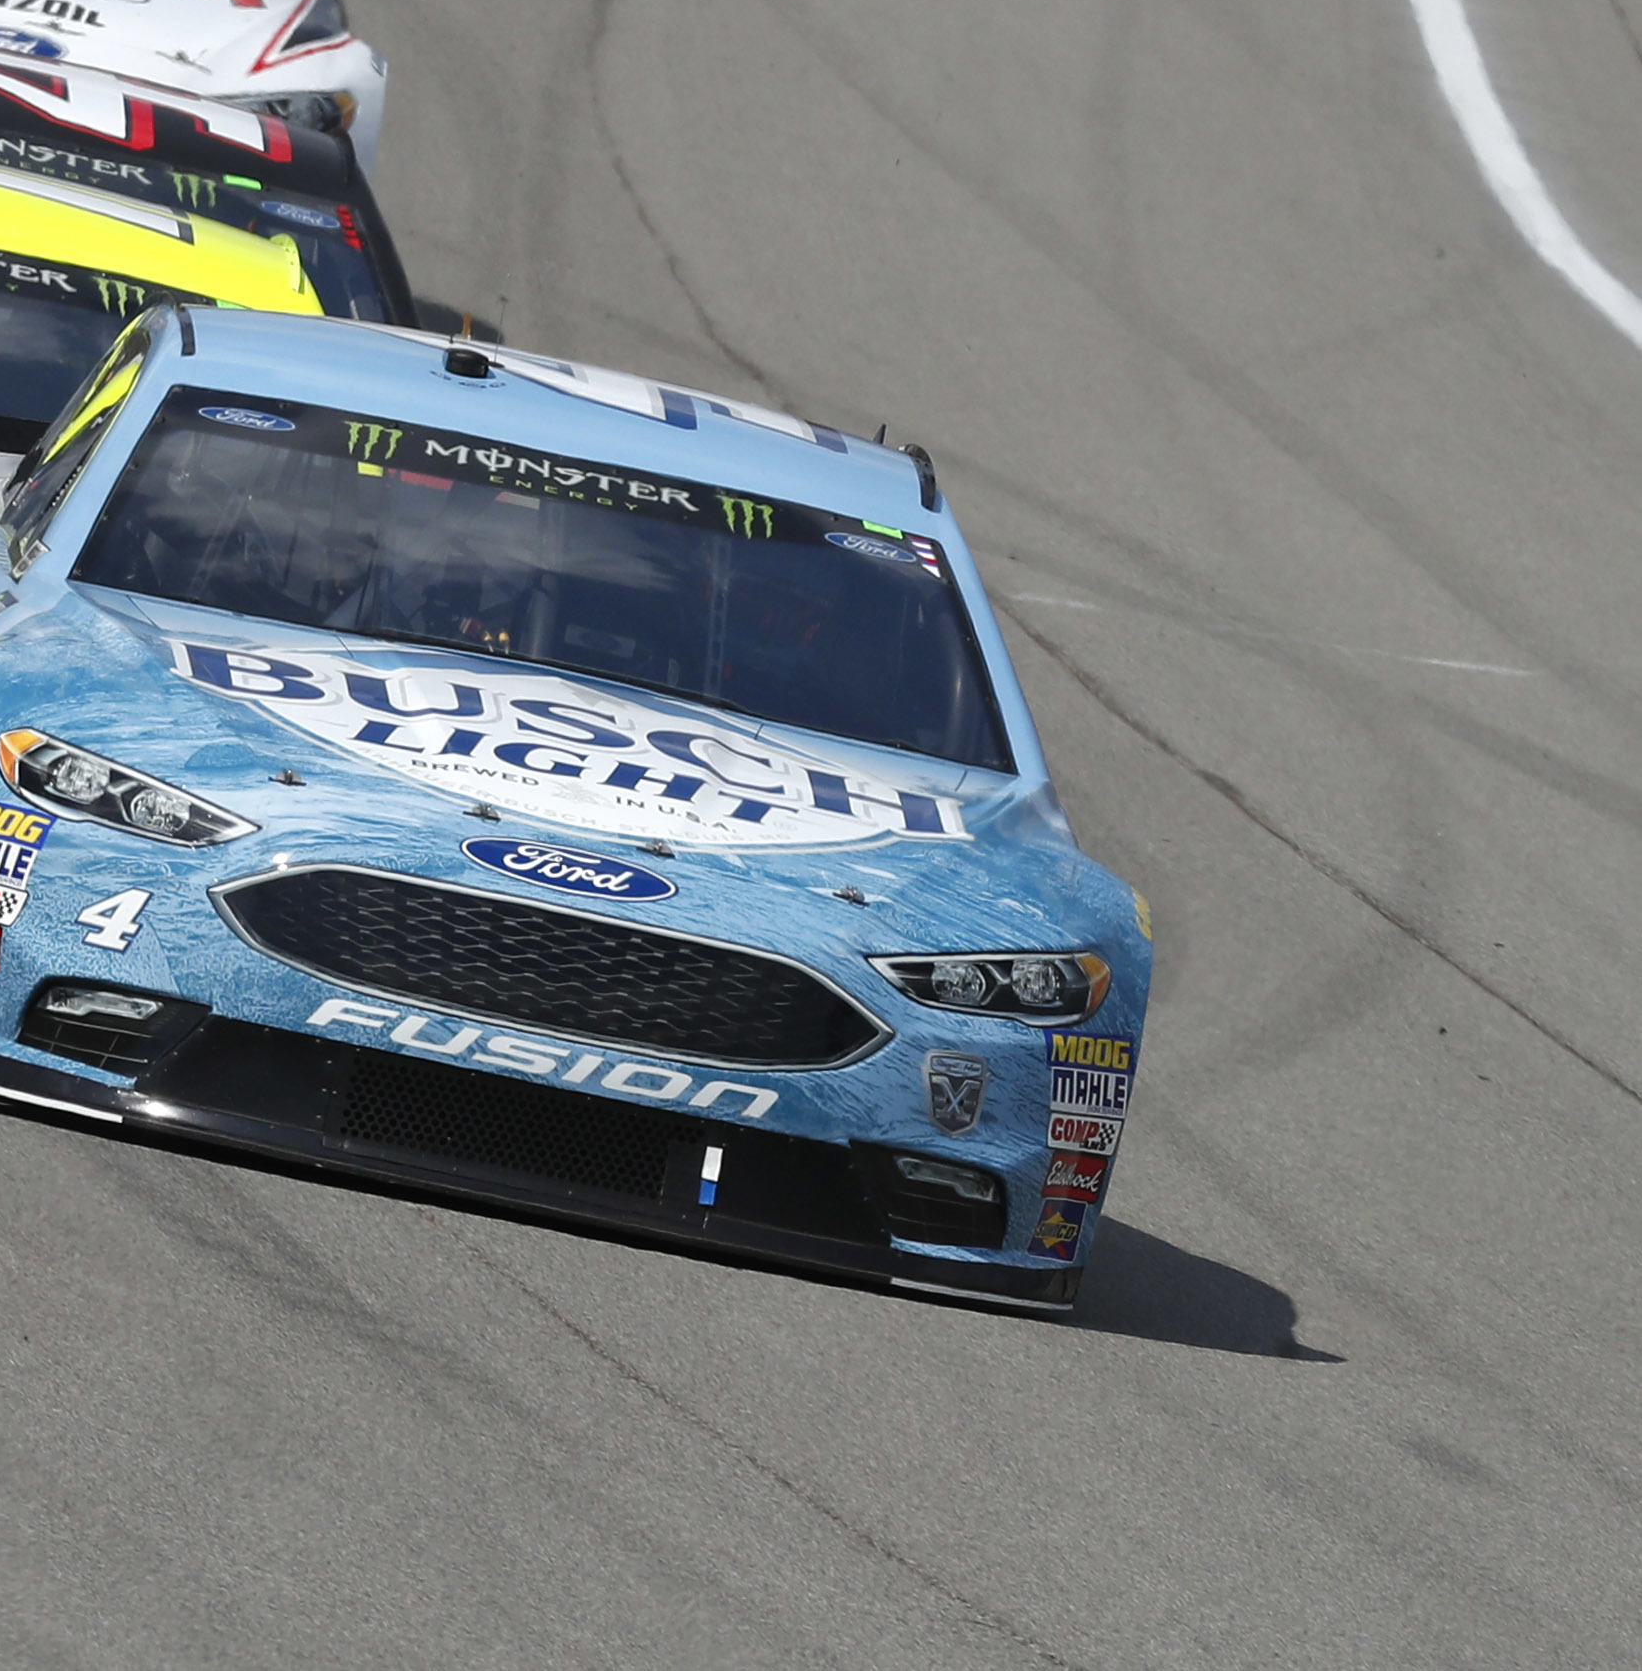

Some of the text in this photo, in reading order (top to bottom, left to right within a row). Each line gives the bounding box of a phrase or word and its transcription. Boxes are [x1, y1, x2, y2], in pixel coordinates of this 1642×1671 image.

[424, 437, 699, 514] MONSTER
[489, 473, 640, 513] ENERGY
[177, 641, 966, 839] BUSCH
[348, 719, 801, 825] LIGHT
[409, 757, 738, 834] BREWED IN U.S.A.
[501, 839, 637, 893] Ford
[77, 887, 152, 952] 4
[305, 998, 779, 1119] FUSION
[1051, 1033, 1132, 1070] MOOG
[1051, 1069, 1127, 1110] MAHLE
[1050, 1117, 1100, 1143] COMP
